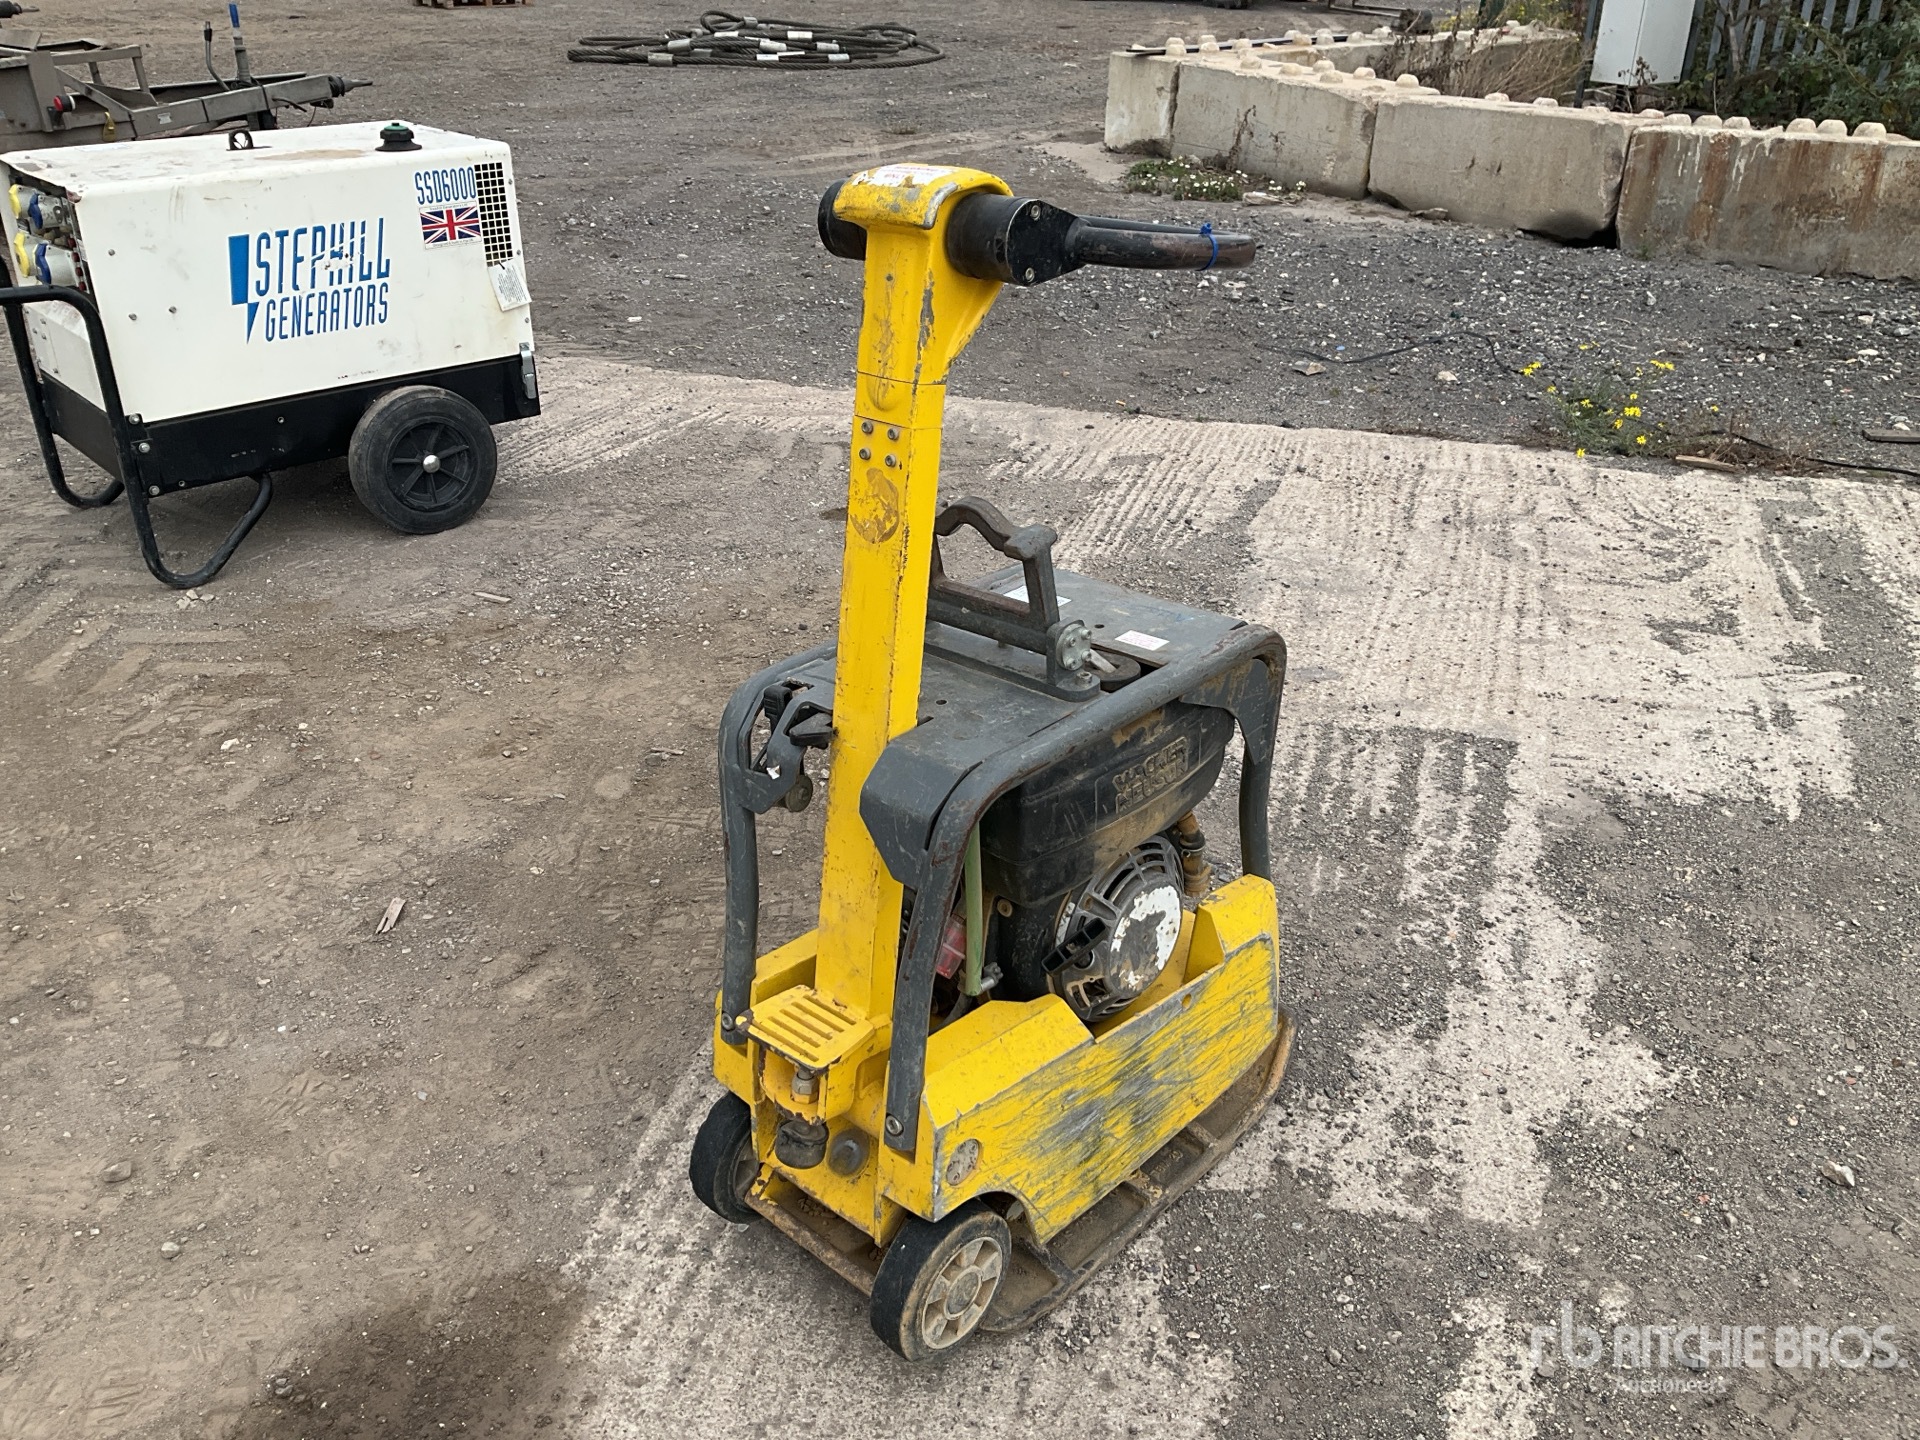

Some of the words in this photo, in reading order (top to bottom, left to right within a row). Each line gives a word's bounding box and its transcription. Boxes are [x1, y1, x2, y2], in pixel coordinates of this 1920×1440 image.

[414, 167, 477, 205] SSD6000
[255, 217, 390, 296] STEPHILL
[265, 282, 389, 342] GENERATORS
